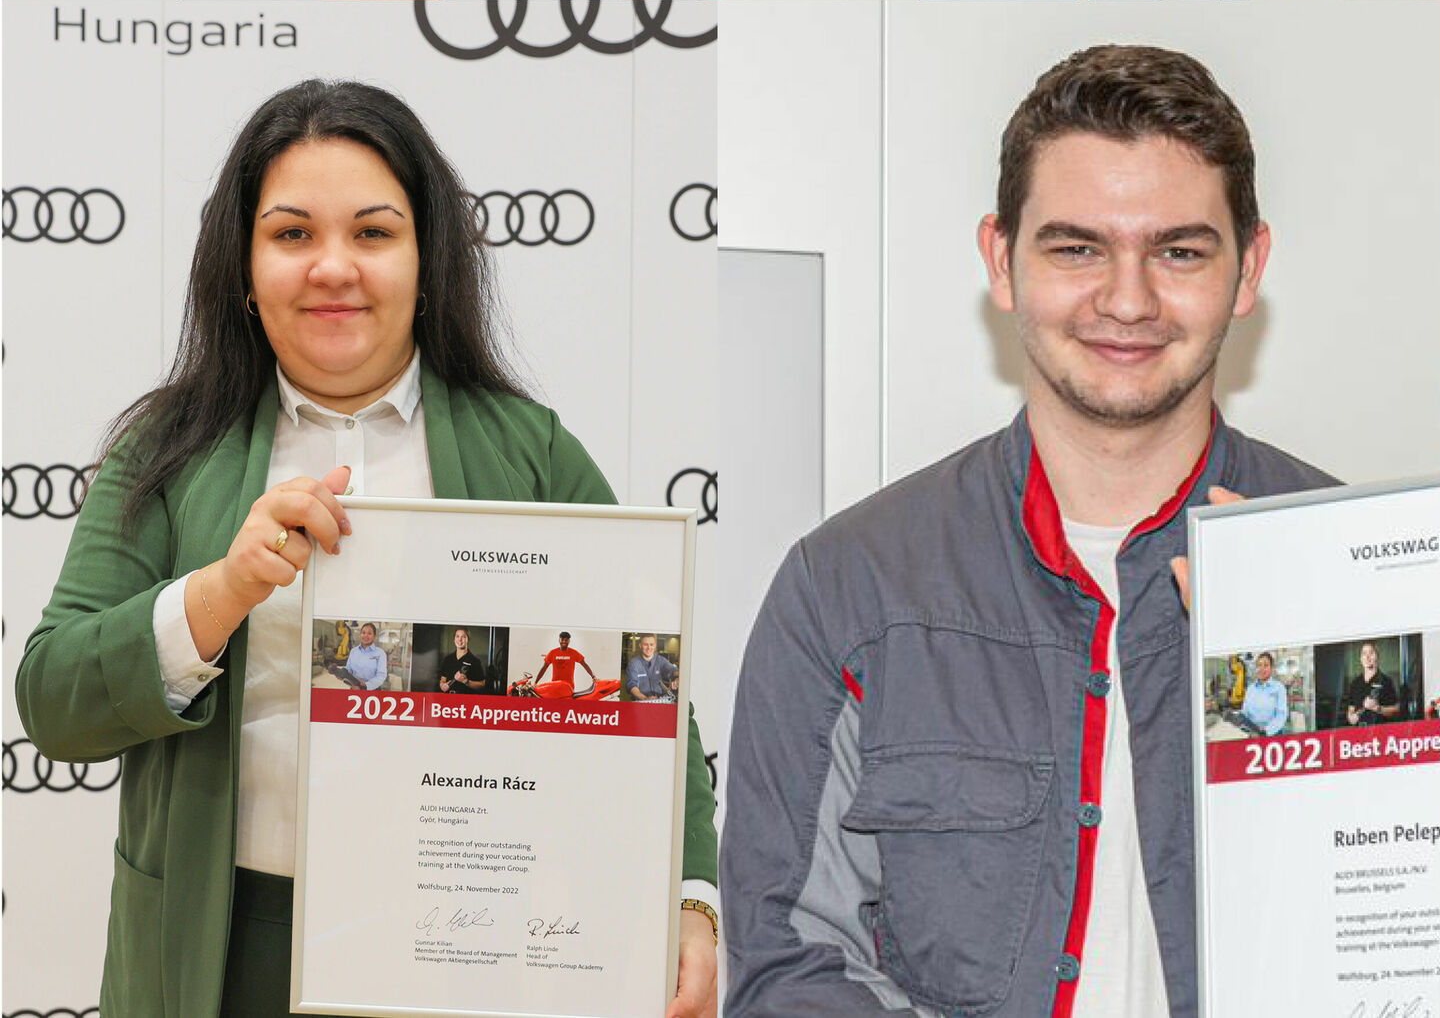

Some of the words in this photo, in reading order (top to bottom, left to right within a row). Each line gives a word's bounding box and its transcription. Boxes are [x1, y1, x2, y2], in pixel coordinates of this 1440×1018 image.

[53, 7, 298, 56] Hungaria
[1350, 538, 1440, 560] VOLKSWAG
[451, 550, 548, 565] VOLKSWAGEN
[346, 695, 415, 721] 2022
[431, 703, 467, 719] Best
[470, 705, 561, 725] Apprentice
[565, 709, 619, 726] Award
[1246, 739, 1322, 774] 2022
[1339, 737, 1381, 759] Best
[1385, 736, 1440, 758] Appre
[421, 773, 497, 789] Alexandra
[503, 776, 536, 791] Rácz
[439, 806, 476, 814] HUNGARIA
[1334, 828, 1388, 847] Ruben
[1394, 823, 1440, 844] Pelep
[427, 840, 465, 848] recognition
[490, 842, 531, 852] outstanding
[418, 850, 461, 858] achievement
[462, 851, 484, 861] during
[418, 861, 444, 870] training
[466, 863, 506, 873] Volkswagen
[507, 865, 529, 874] Group.
[417, 883, 453, 893] Wolfsburg,
